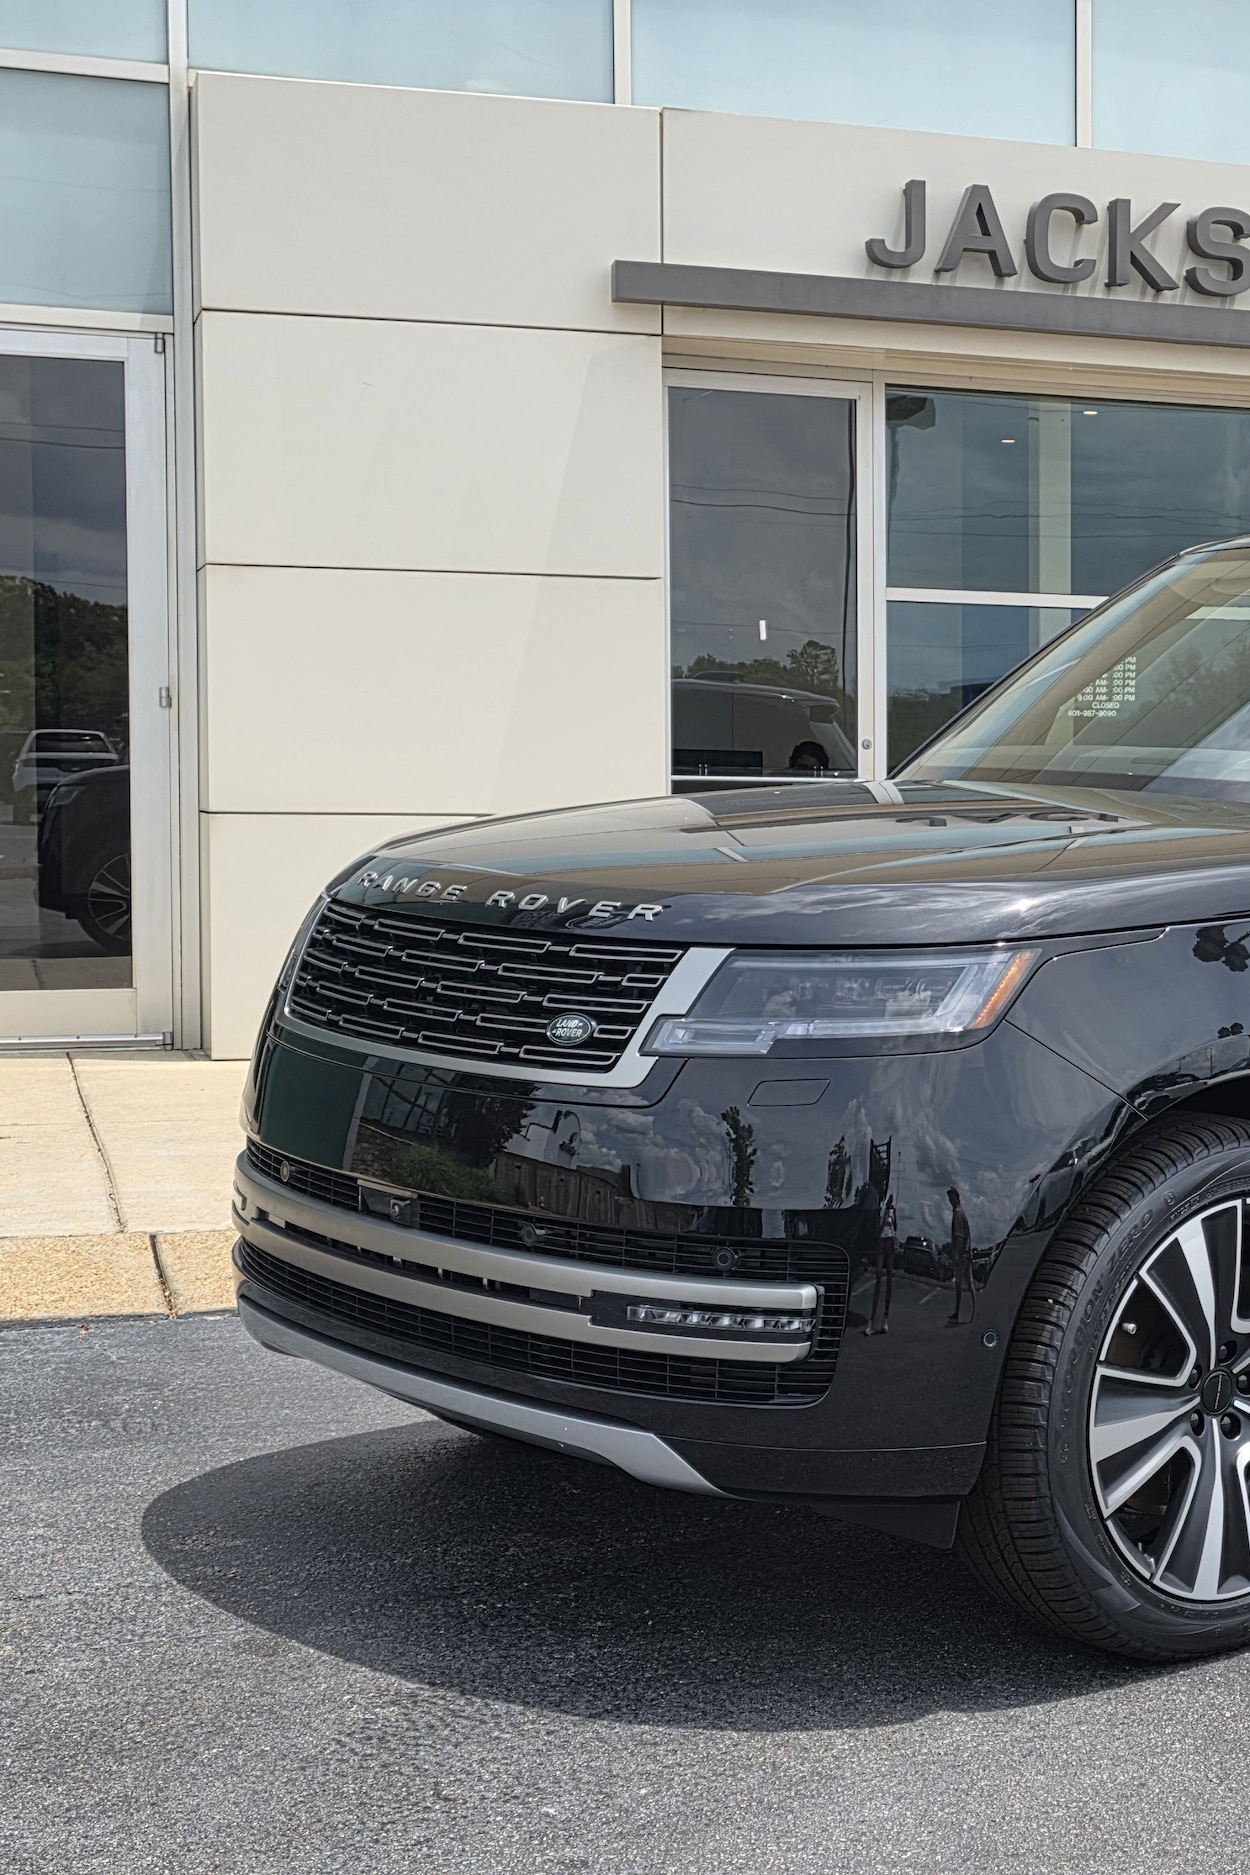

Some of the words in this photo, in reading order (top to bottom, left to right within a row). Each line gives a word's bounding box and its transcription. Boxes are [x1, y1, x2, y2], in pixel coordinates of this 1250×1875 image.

[1124, 671, 1136, 679] PM
[1124, 694, 1136, 702] PM
[356, 870, 468, 901] RANGE
[485, 890, 664, 922] ROVER
